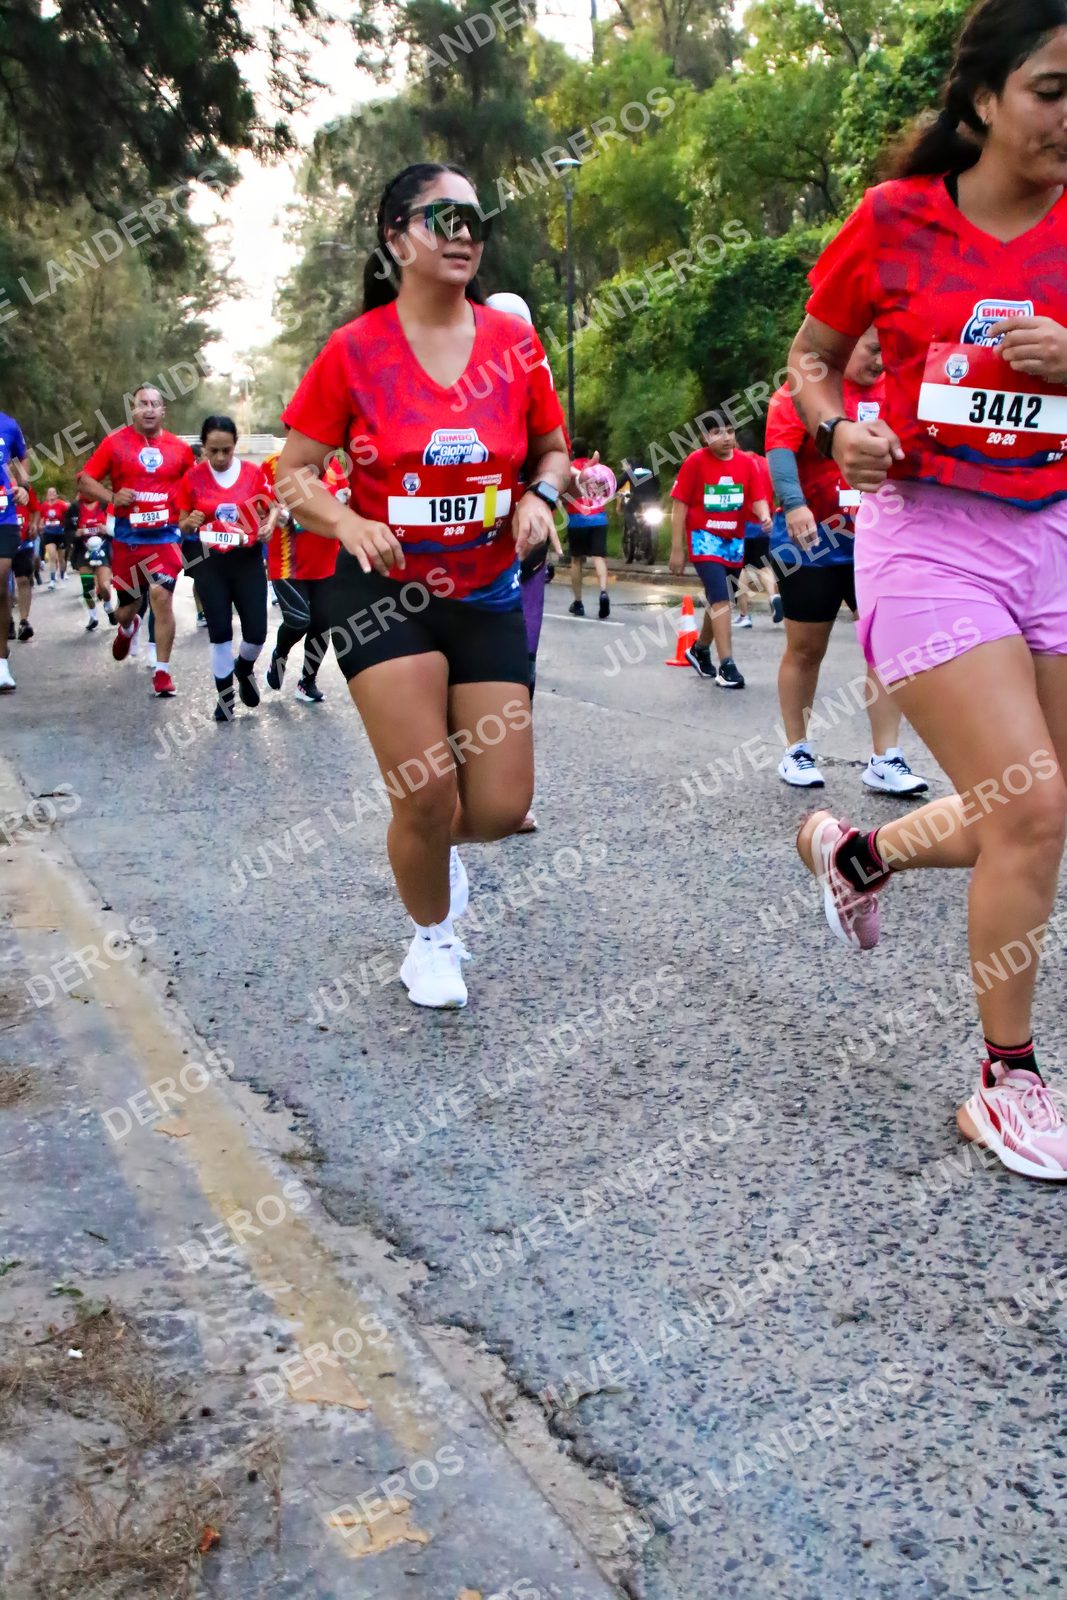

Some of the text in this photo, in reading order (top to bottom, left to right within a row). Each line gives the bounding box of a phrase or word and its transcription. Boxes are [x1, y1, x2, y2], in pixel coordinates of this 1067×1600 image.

[982, 308, 1025, 317] BIMBO
[969, 391, 1043, 429] 3442
[438, 434, 472, 443] BIMBO
[440, 444, 473, 456] Global
[434, 455, 460, 466] Race
[429, 496, 478, 523] 1967
[141, 512, 160, 521] 2334
